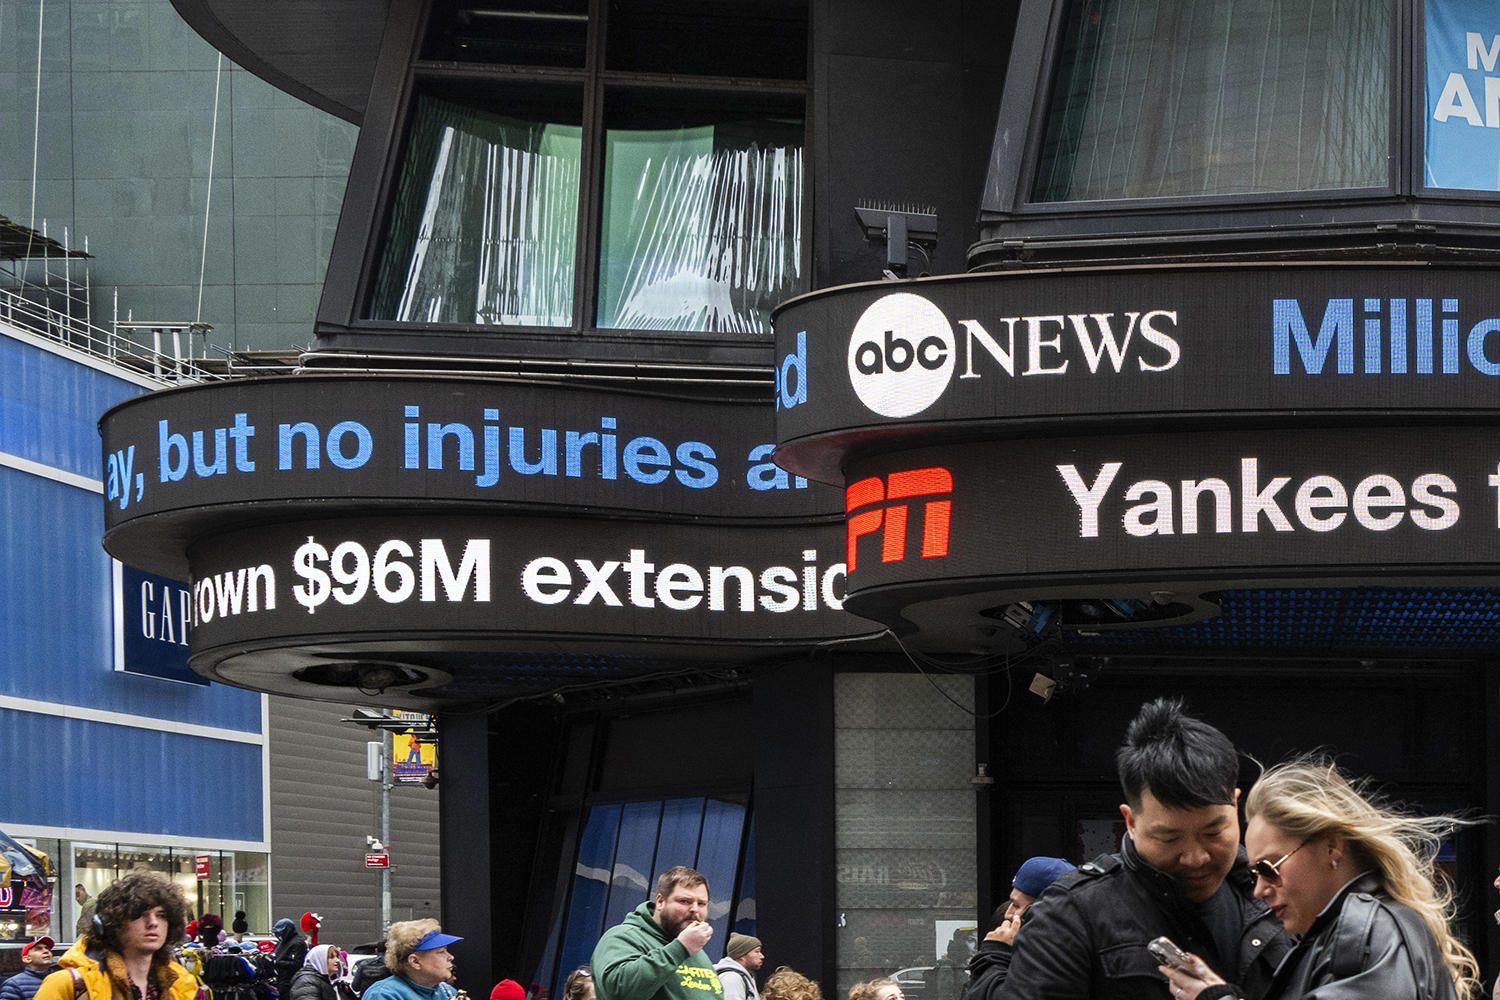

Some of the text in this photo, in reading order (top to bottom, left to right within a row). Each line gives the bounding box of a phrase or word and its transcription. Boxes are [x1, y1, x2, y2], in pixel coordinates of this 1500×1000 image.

[855, 311, 1181, 379] abc NEWS
[158, 412, 256, 483] but
[277, 421, 374, 471] no
[404, 406, 719, 489] injuries
[1056, 457, 1460, 538] Yankees
[141, 580, 191, 646] GAP
[292, 535, 491, 614] $96M
